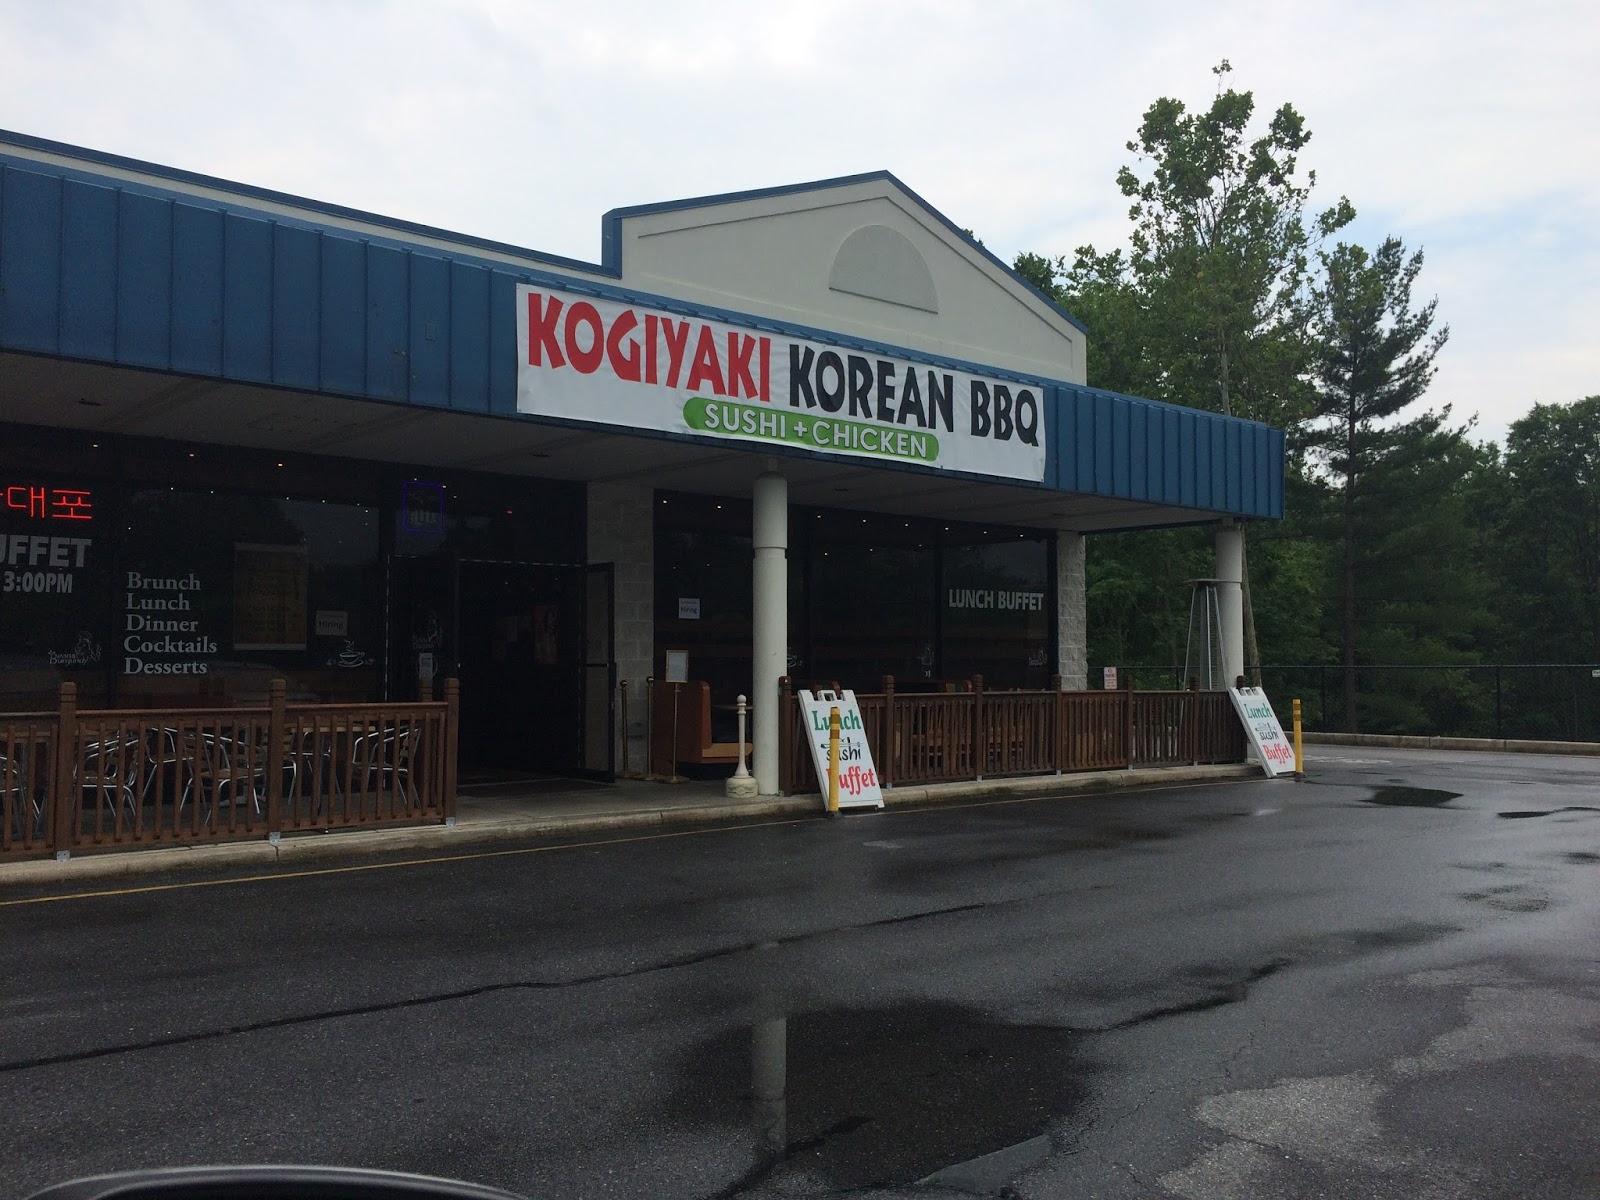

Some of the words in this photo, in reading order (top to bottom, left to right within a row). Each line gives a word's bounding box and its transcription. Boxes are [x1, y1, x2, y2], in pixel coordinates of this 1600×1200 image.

[528, 293, 771, 402] KOGIYAKI
[789, 344, 954, 432] KOREAN
[970, 380, 1039, 447] BBQ
[704, 403, 786, 439] SUSHI
[812, 421, 927, 458] CHICKEN
[0, 487, 92, 518] 대포
[3, 571, 73, 594] 3:00PM
[126, 571, 202, 591] Brunch
[125, 592, 191, 611] Lunch
[949, 589, 994, 609] LUNCH
[998, 590, 1044, 611] BUFFET
[125, 613, 199, 632] Dinner
[123, 635, 218, 653] Cocktails
[123, 657, 207, 675] Desserts
[1243, 703, 1273, 719] Lunch
[1259, 722, 1280, 741] sushi
[825, 737, 862, 761] sshi
[1262, 743, 1292, 765] Buffet
[825, 765, 876, 796] uffet
